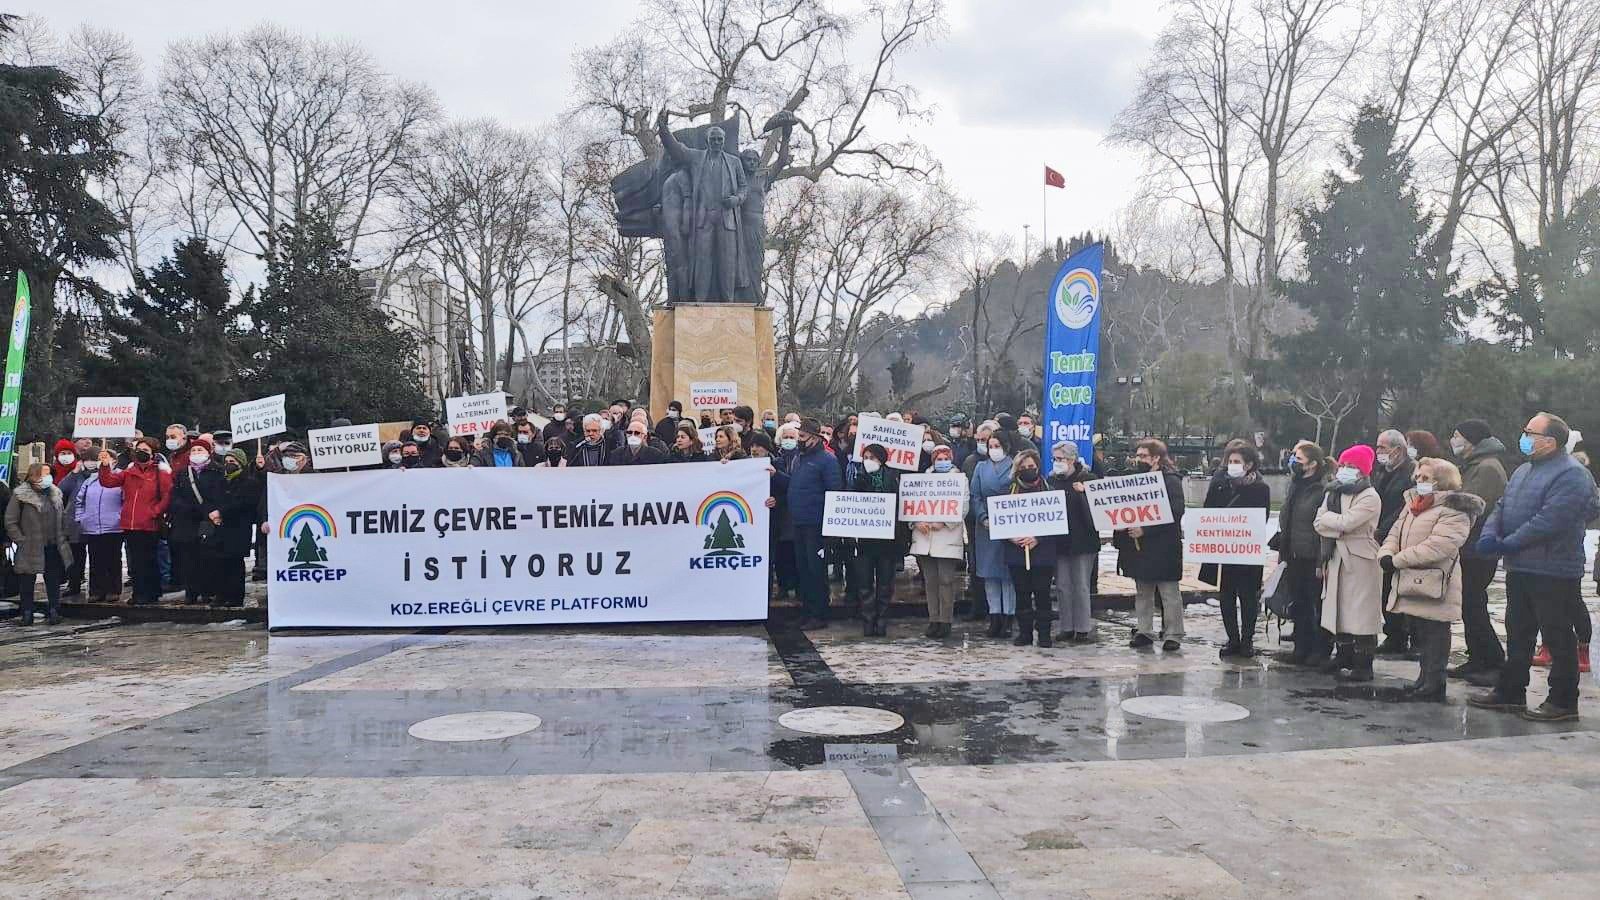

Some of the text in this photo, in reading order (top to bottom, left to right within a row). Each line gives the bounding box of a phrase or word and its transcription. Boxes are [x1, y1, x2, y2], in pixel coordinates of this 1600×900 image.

[1050, 349, 1095, 374] Temiz
[1050, 383, 1092, 409] Çevre
[78, 417, 134, 426] DOKUNMAYIN!
[236, 415, 283, 436] AÇILSIN
[452, 420, 497, 434] YER VA
[315, 431, 372, 442] TEMİZ ÇEVRE
[872, 424, 907, 437] SAHİLDE
[1050, 420, 1090, 441] Temiz
[313, 442, 378, 456] İSTİYORUZ
[936, 478, 960, 487] DEĞİL
[1089, 475, 1159, 492] SAHİLİMİZİN
[994, 496, 1060, 510] TEMİZ HAVA
[1094, 488, 1164, 507] ALTERNATİFİ
[834, 506, 886, 515] BÜTÜNLÜĞÜ
[903, 499, 959, 516] HAYIR
[1104, 504, 1161, 525] YOK!
[346, 504, 425, 534] TEMİZ
[622, 501, 690, 526] HAVA
[827, 517, 892, 527] BOZULMASIN
[994, 511, 1065, 526] İSTİYORUZ
[1200, 514, 1248, 524] SAHİLİMİZ
[1196, 528, 1252, 537] KENTİMİZİN
[1189, 542, 1262, 554] SEMBOLÜDÜR
[404, 550, 631, 581] İSTİYORUZ
[690, 555, 763, 570] KERÇEP
[276, 568, 347, 583] KERÇEP
[391, 596, 649, 616] KDZ.EREĞLİ ÇEVRE PLATFORMU
